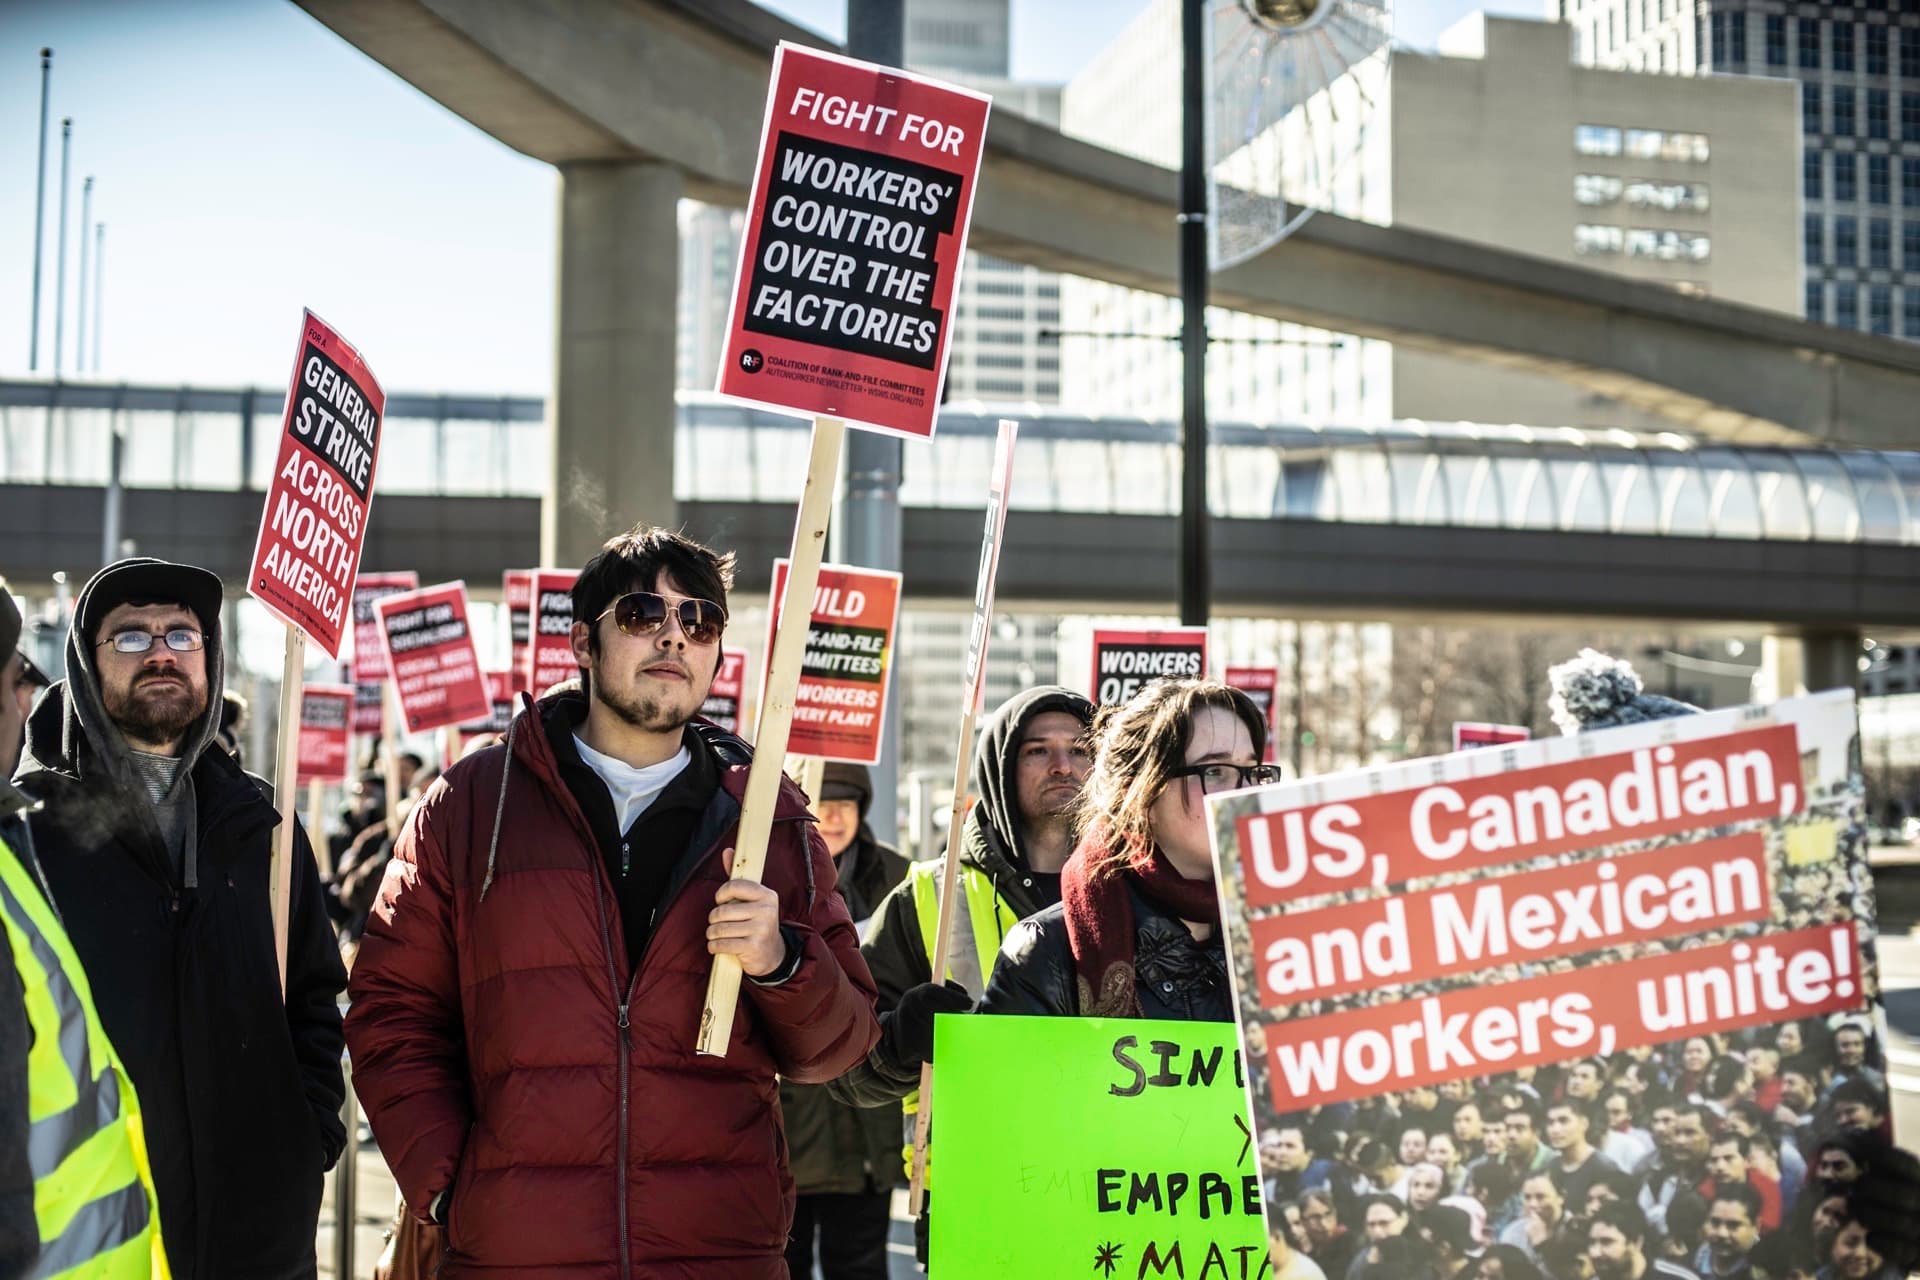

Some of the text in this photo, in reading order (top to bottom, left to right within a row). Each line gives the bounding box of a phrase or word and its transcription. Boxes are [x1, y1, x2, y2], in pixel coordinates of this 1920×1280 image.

[790, 87, 965, 156] FIGHT FOR
[780, 148, 953, 215] WORKERS'
[771, 195, 927, 260] CONTROL
[764, 241, 931, 305] OVER THE
[308, 328, 327, 348] FOR A
[752, 285, 937, 353] FACTORIES
[305, 356, 376, 448] GENERAL
[766, 368, 816, 384] AUTOWORKER
[816, 377, 863, 393] NEWSLETTER
[767, 356, 925, 396] COALITION OF RANK-AND-FILE COMMITTEES
[296, 397, 372, 492] STRIKE
[281, 449, 361, 539] ACROSS
[272, 491, 355, 588] NORTH
[262, 542, 343, 629] AMERICA
[799, 683, 879, 709] WORKERS
[1101, 651, 1201, 674] WORKERS
[828, 708, 875, 728] PLANT
[1248, 745, 1798, 889] US, Canadian,
[1265, 854, 1762, 997] and Mexican
[1276, 928, 1854, 1098] workers, unite!
